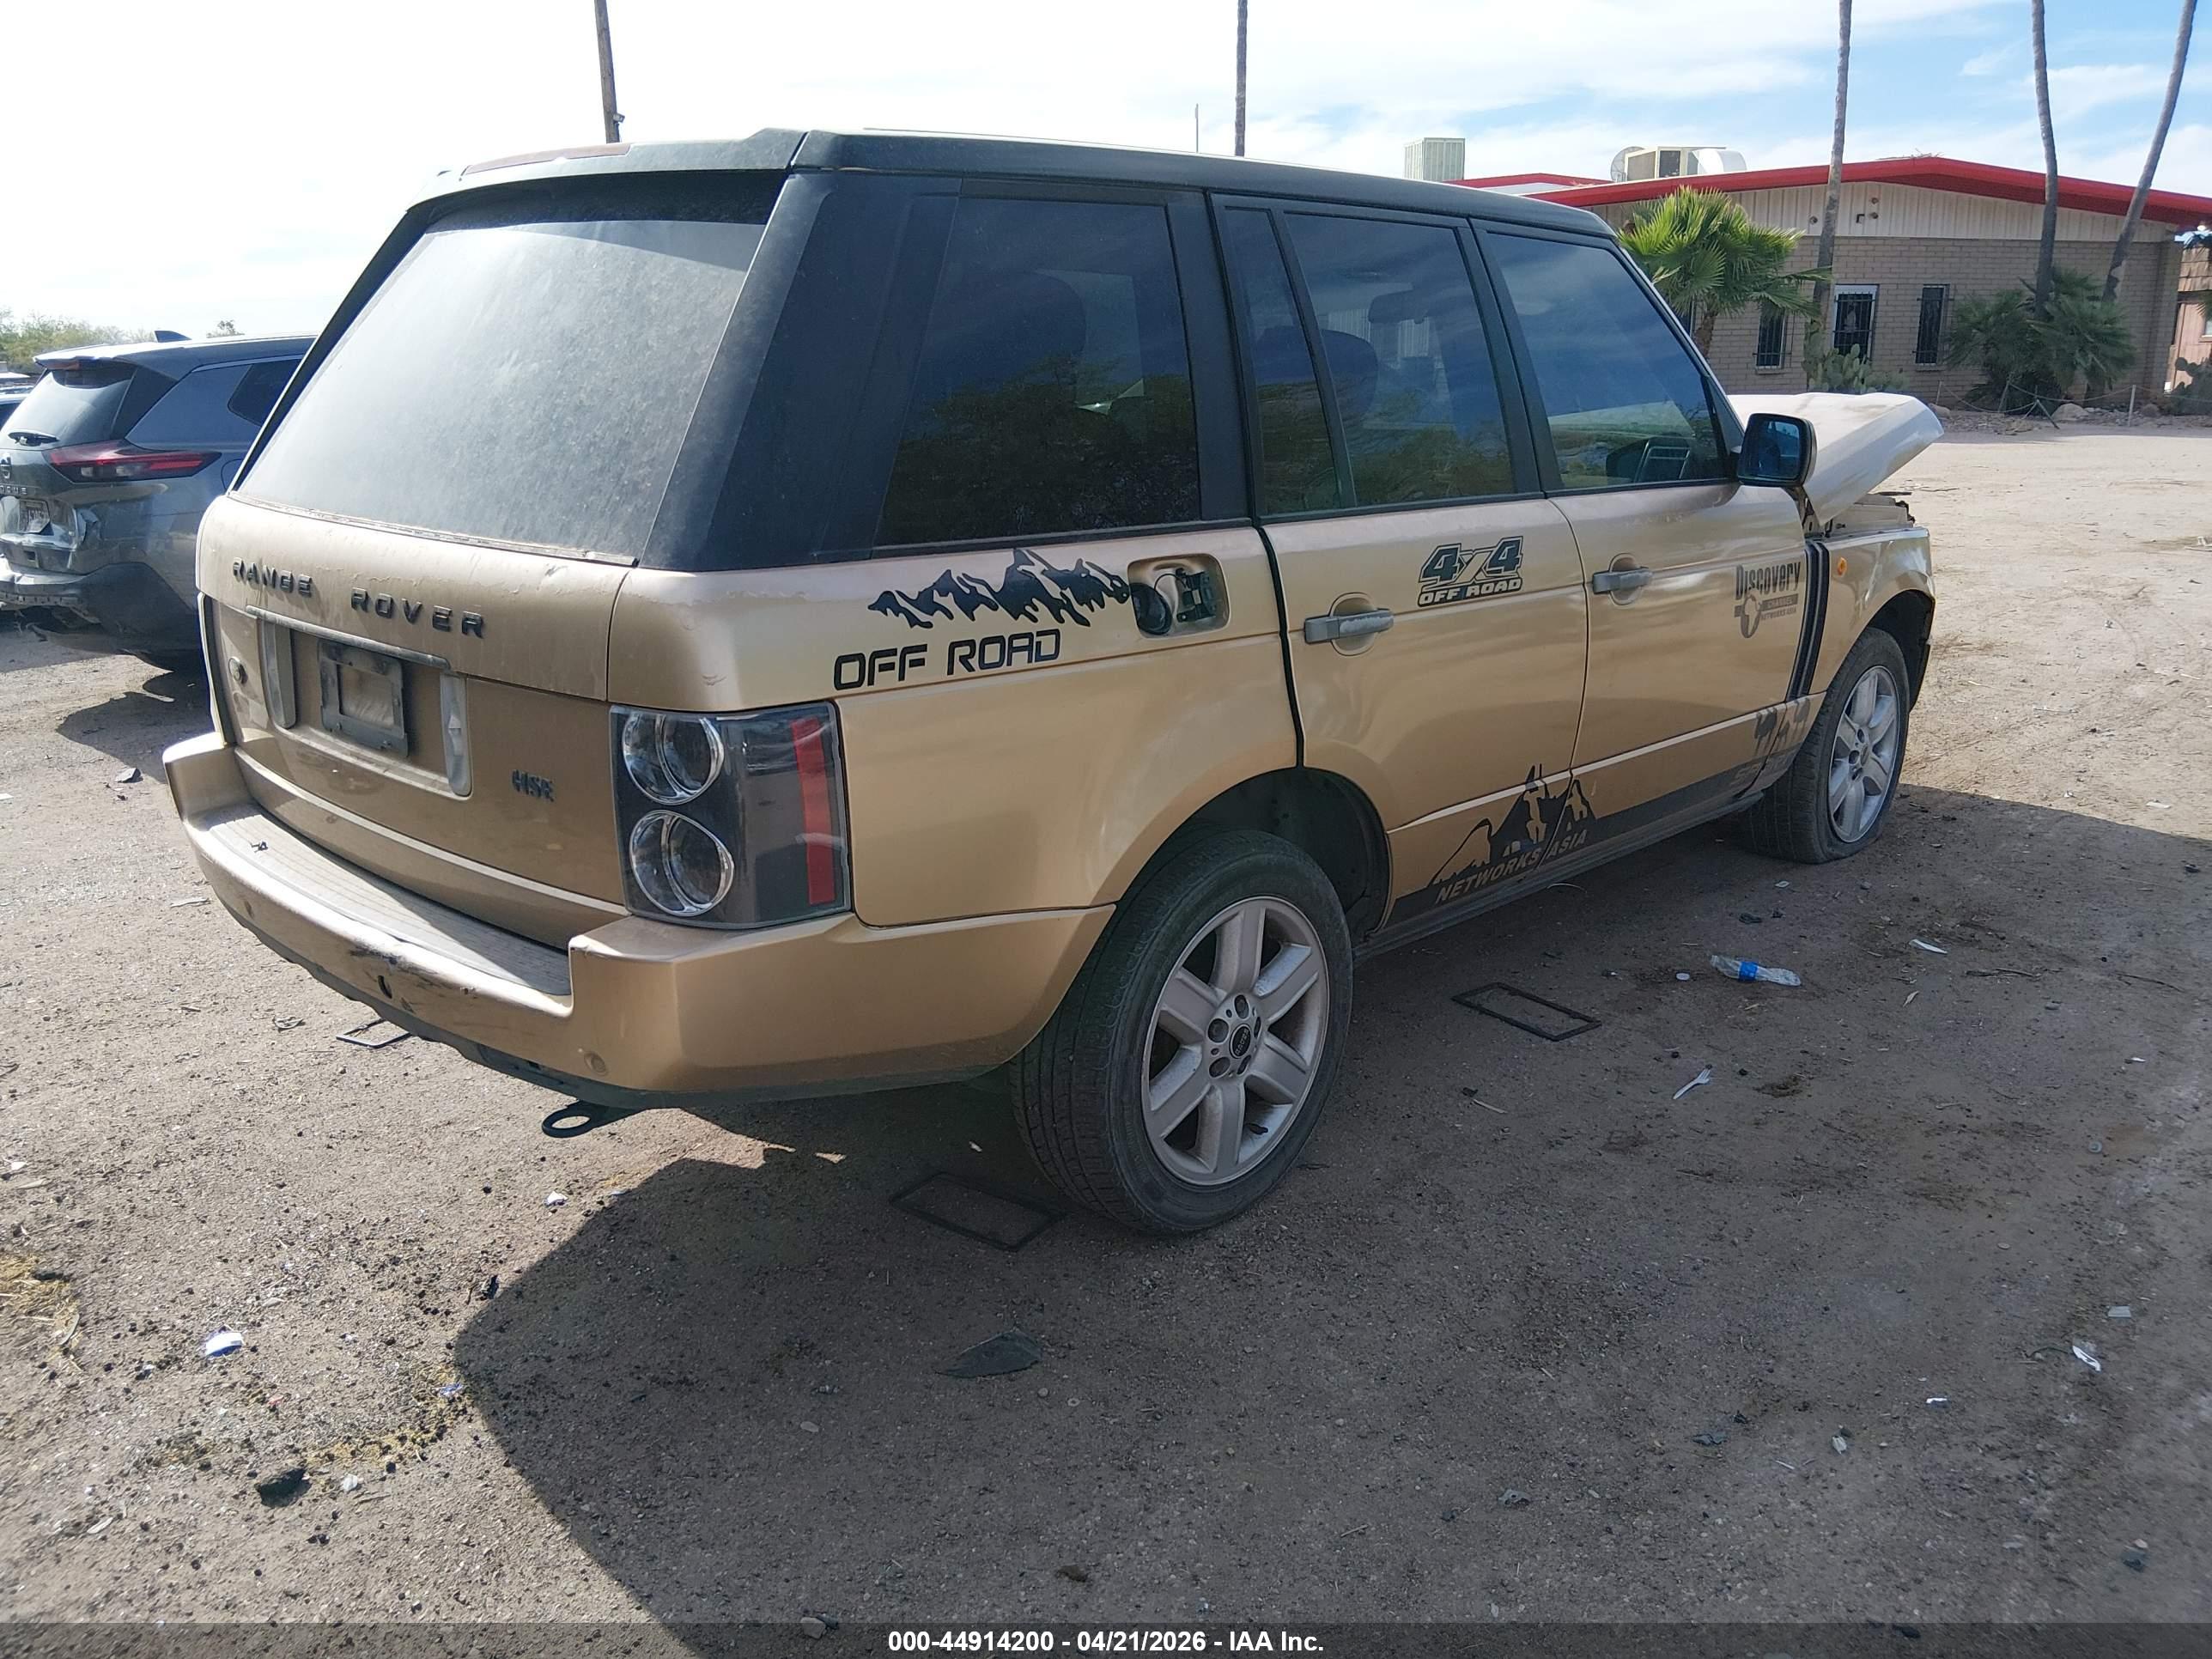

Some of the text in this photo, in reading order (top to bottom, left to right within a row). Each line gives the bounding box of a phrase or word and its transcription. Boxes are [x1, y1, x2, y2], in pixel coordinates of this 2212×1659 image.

[233, 556, 484, 639] RANGE ROVER
[1419, 579, 1522, 605] OFF ROAD
[1735, 562, 1801, 600] Discovery
[833, 629, 1060, 690] OFF ROAD
[1436, 830, 1588, 903] NETWORKS ASIA
